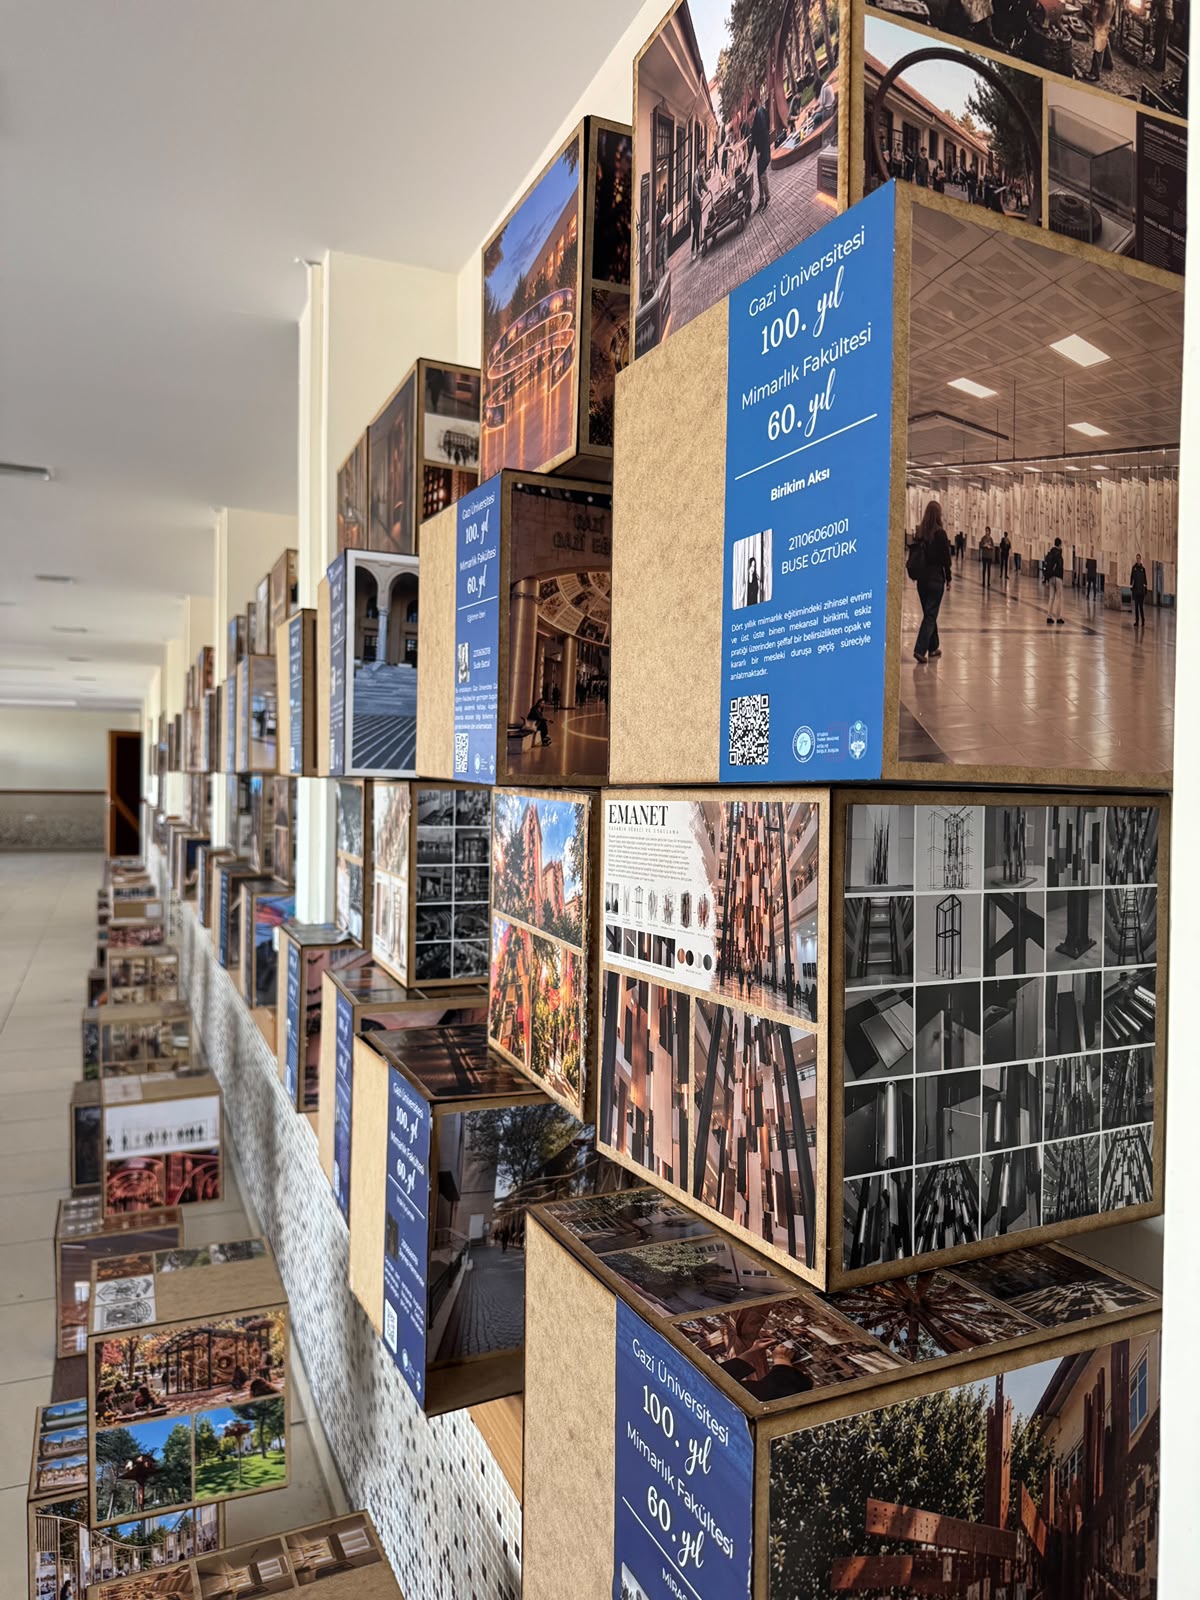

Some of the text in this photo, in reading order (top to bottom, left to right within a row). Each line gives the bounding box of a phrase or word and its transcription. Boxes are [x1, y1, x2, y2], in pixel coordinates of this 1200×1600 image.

[749, 226, 865, 316] Gazi Üniversitesi
[762, 265, 844, 355] 100. yıl
[742, 322, 871, 410] Mimarlık Fakültesi
[768, 368, 836, 440] 60. yıl
[771, 468, 829, 501] Birikim Aksı
[466, 523, 479, 544] 100.
[789, 519, 848, 550] 21106060101
[782, 539, 857, 574] BUSE ÖZTÜRK
[467, 576, 478, 594] 60.
[732, 624, 743, 632] Dört
[758, 614, 782, 625] mimarlık
[784, 602, 822, 621] eğitimindeki
[824, 596, 848, 609] zihinsel
[850, 590, 872, 602] evrimi
[741, 633, 749, 642] üst
[753, 630, 764, 640] üste
[769, 626, 785, 636] binen
[790, 617, 818, 631] mekansal
[854, 605, 871, 617] eskiz
[731, 646, 748, 657] pratiği
[749, 640, 776, 652] üzerinden
[777, 635, 792, 648] şeffaf
[794, 635, 802, 644] bir
[803, 626, 842, 641] belirsizlikten
[844, 624, 861, 635] opak
[764, 650, 785, 662] mesleki
[791, 645, 811, 658] duruşa
[818, 642, 835, 654] geçiş
[841, 635, 870, 647] süreciyle
[731, 668, 768, 680] anlatmaktadır.
[609, 805, 668, 826] EMANET
[633, 1338, 729, 1446] Gazi Üniversitesi
[643, 1385, 711, 1475] 100. yıl
[627, 1422, 733, 1559] Mimarlık Fakültesi
[648, 1486, 704, 1568] 60. yıl
